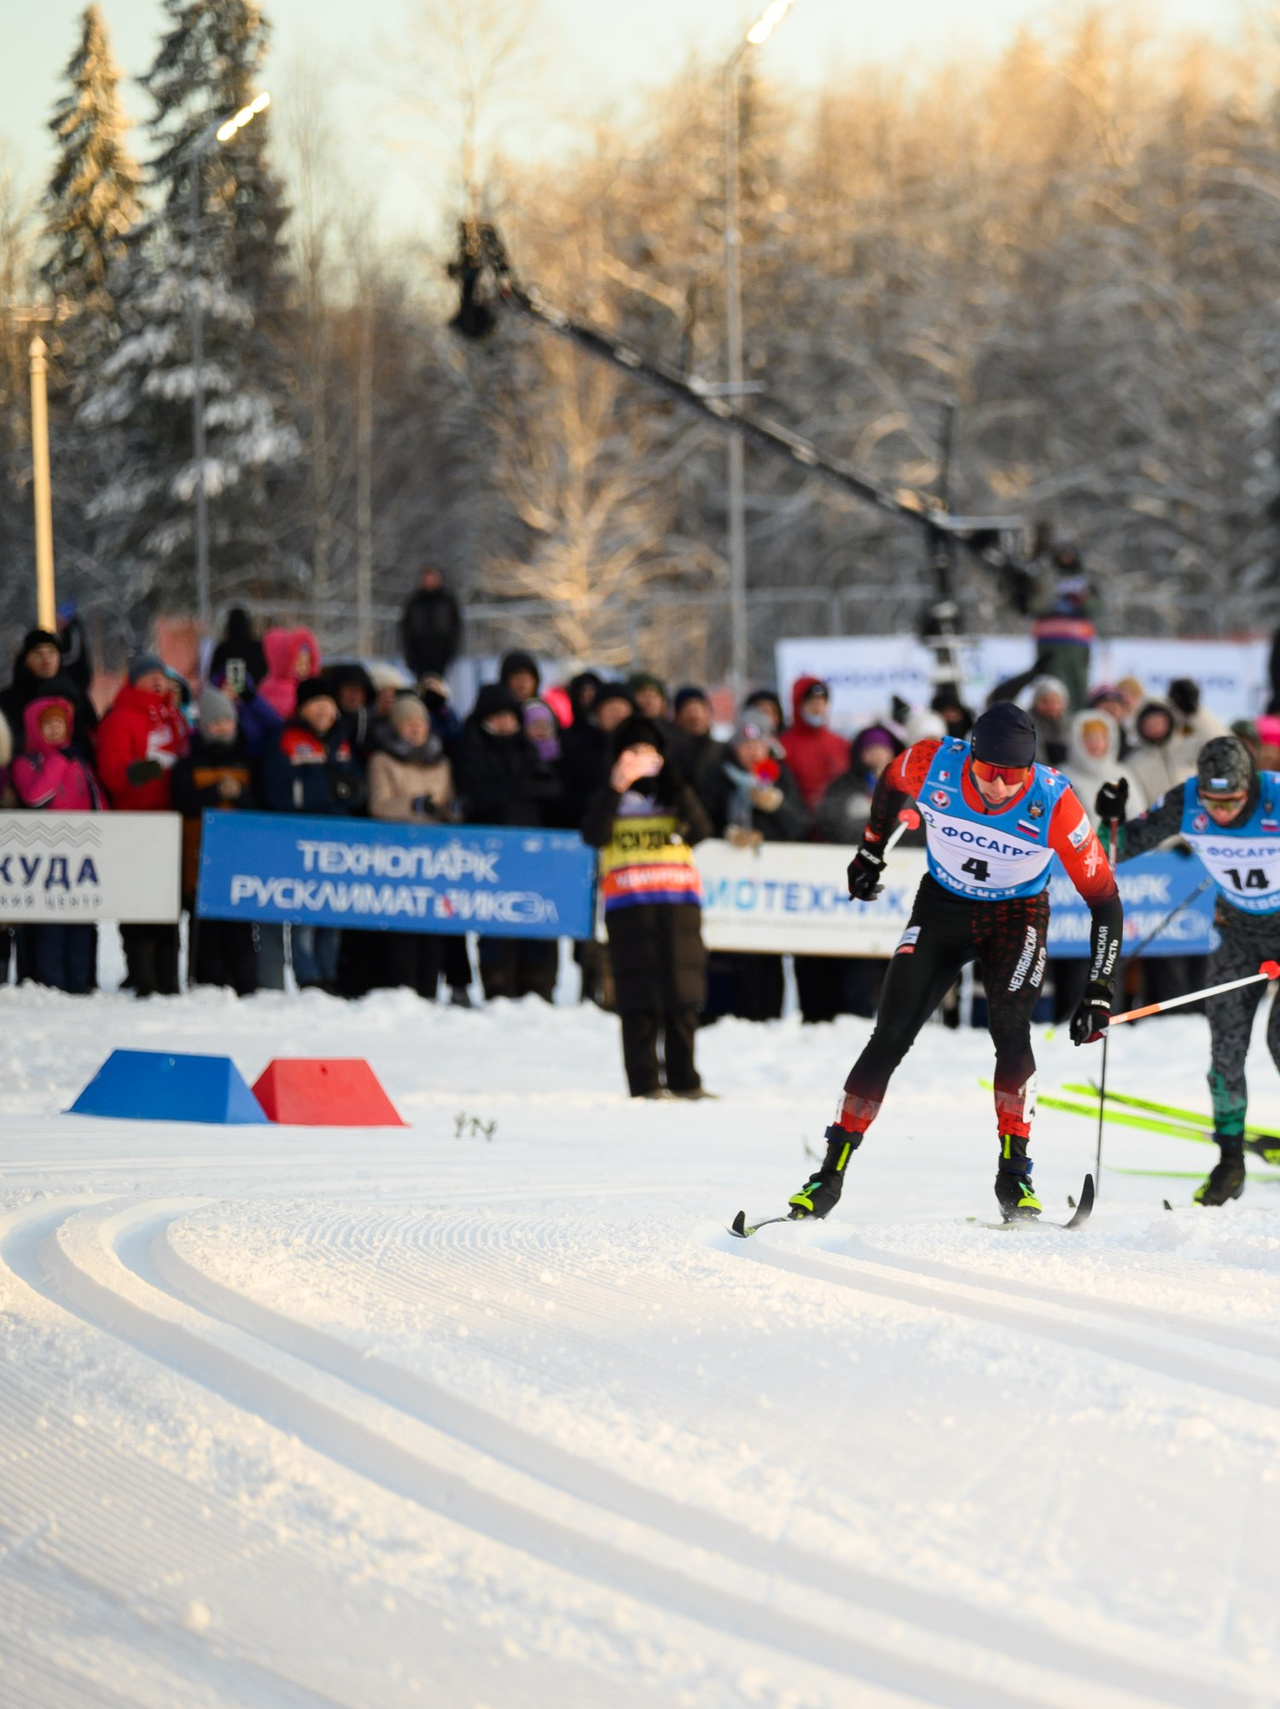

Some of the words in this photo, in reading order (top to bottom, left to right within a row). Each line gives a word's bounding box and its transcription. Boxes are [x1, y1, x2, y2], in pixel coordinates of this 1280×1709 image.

[296, 840, 499, 883] ТЕХНОПАРК
[961, 857, 990, 882] 4
[1221, 869, 1270, 891] 14
[230, 874, 436, 919] РУСКЛИМАТ
[1008, 925, 1038, 992] ЧЕЛЯБИНСКАЯ
